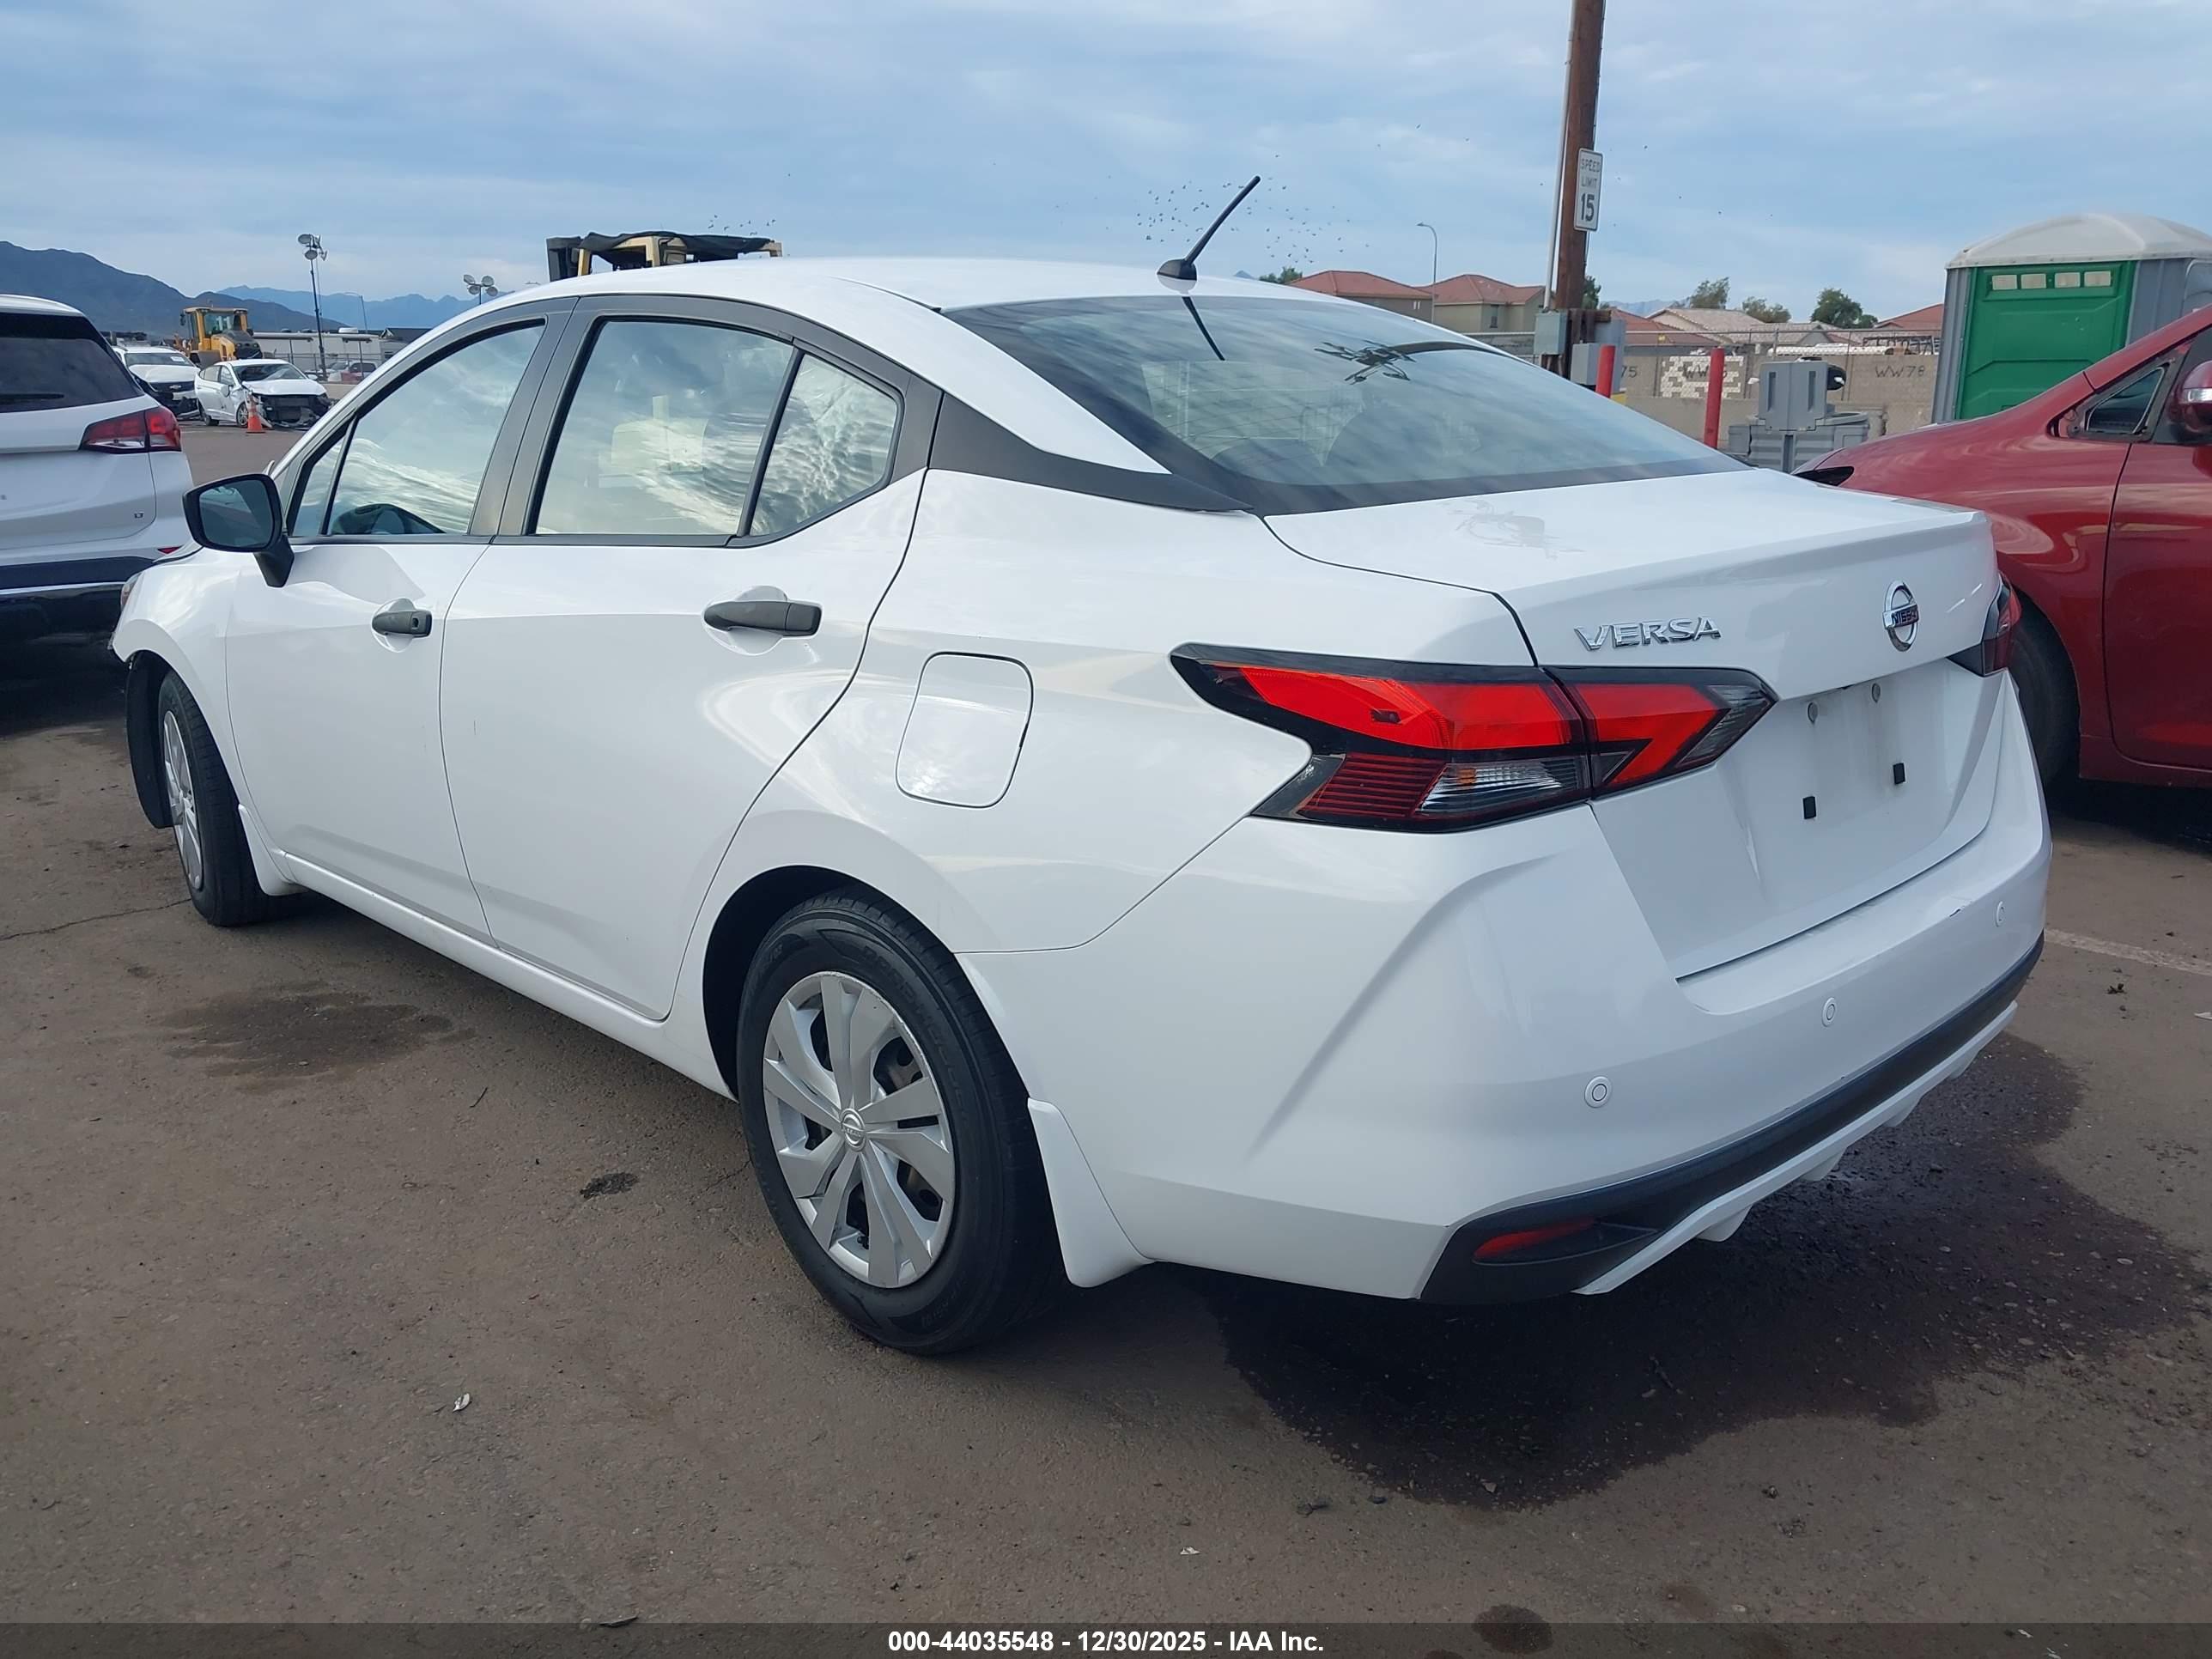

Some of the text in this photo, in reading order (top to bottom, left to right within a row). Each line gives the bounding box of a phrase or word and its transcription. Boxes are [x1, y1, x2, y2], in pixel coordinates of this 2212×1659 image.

[1582, 158, 1601, 173] SPEED
[1581, 174, 1598, 190] LIMIT
[1581, 193, 1595, 222] 15
[1573, 617, 1722, 651] VERSA
